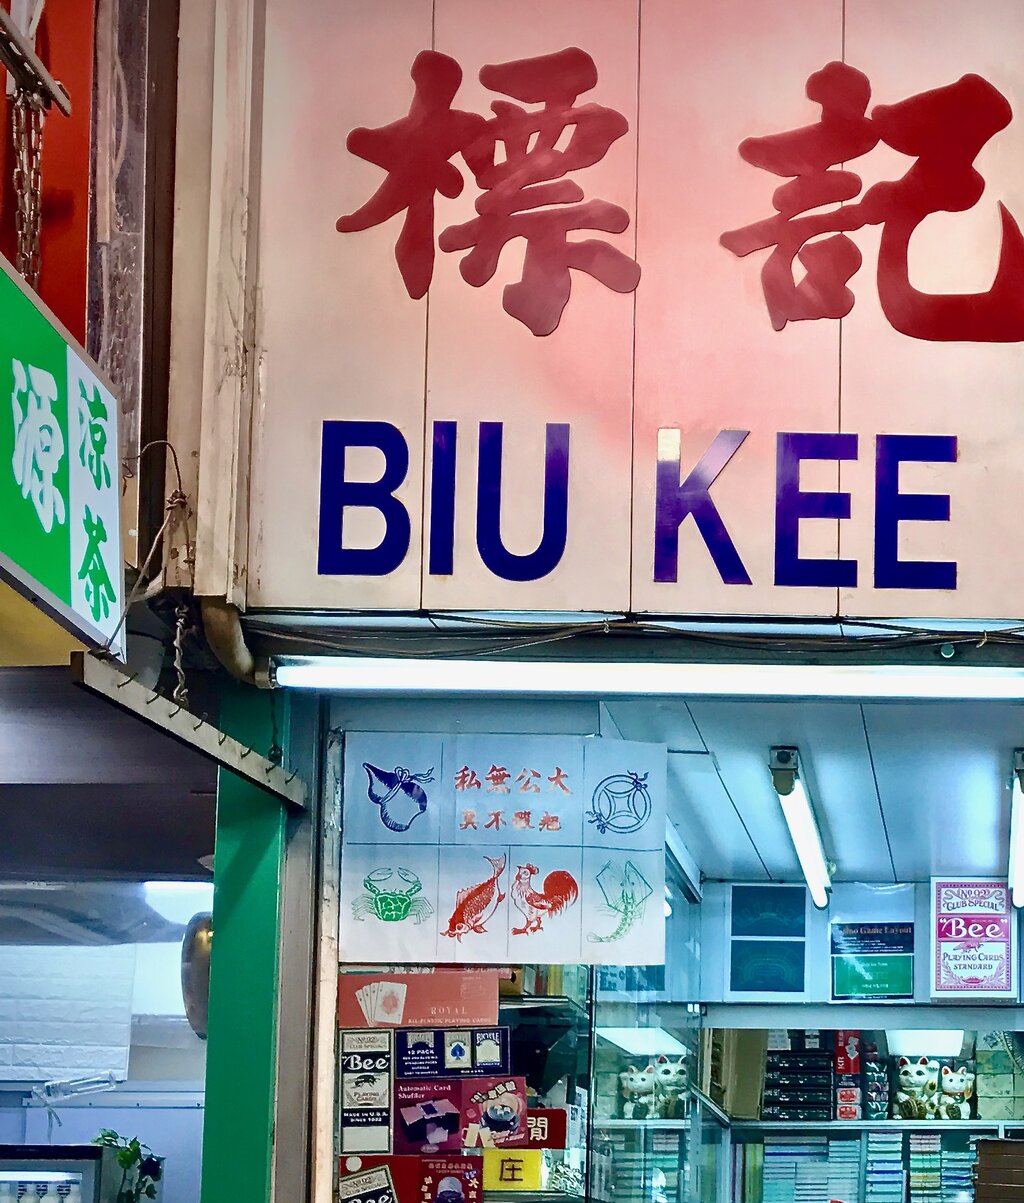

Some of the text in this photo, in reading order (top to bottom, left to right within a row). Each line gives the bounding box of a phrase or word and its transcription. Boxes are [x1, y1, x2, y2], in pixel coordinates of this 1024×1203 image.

[317, 420, 571, 582] BIU
[653, 428, 958, 590] KEE
[946, 899, 1000, 911] CLUB SPECIAL
[942, 952, 1004, 961] PLAYING CARDS
[953, 963, 993, 971] STANDARD
